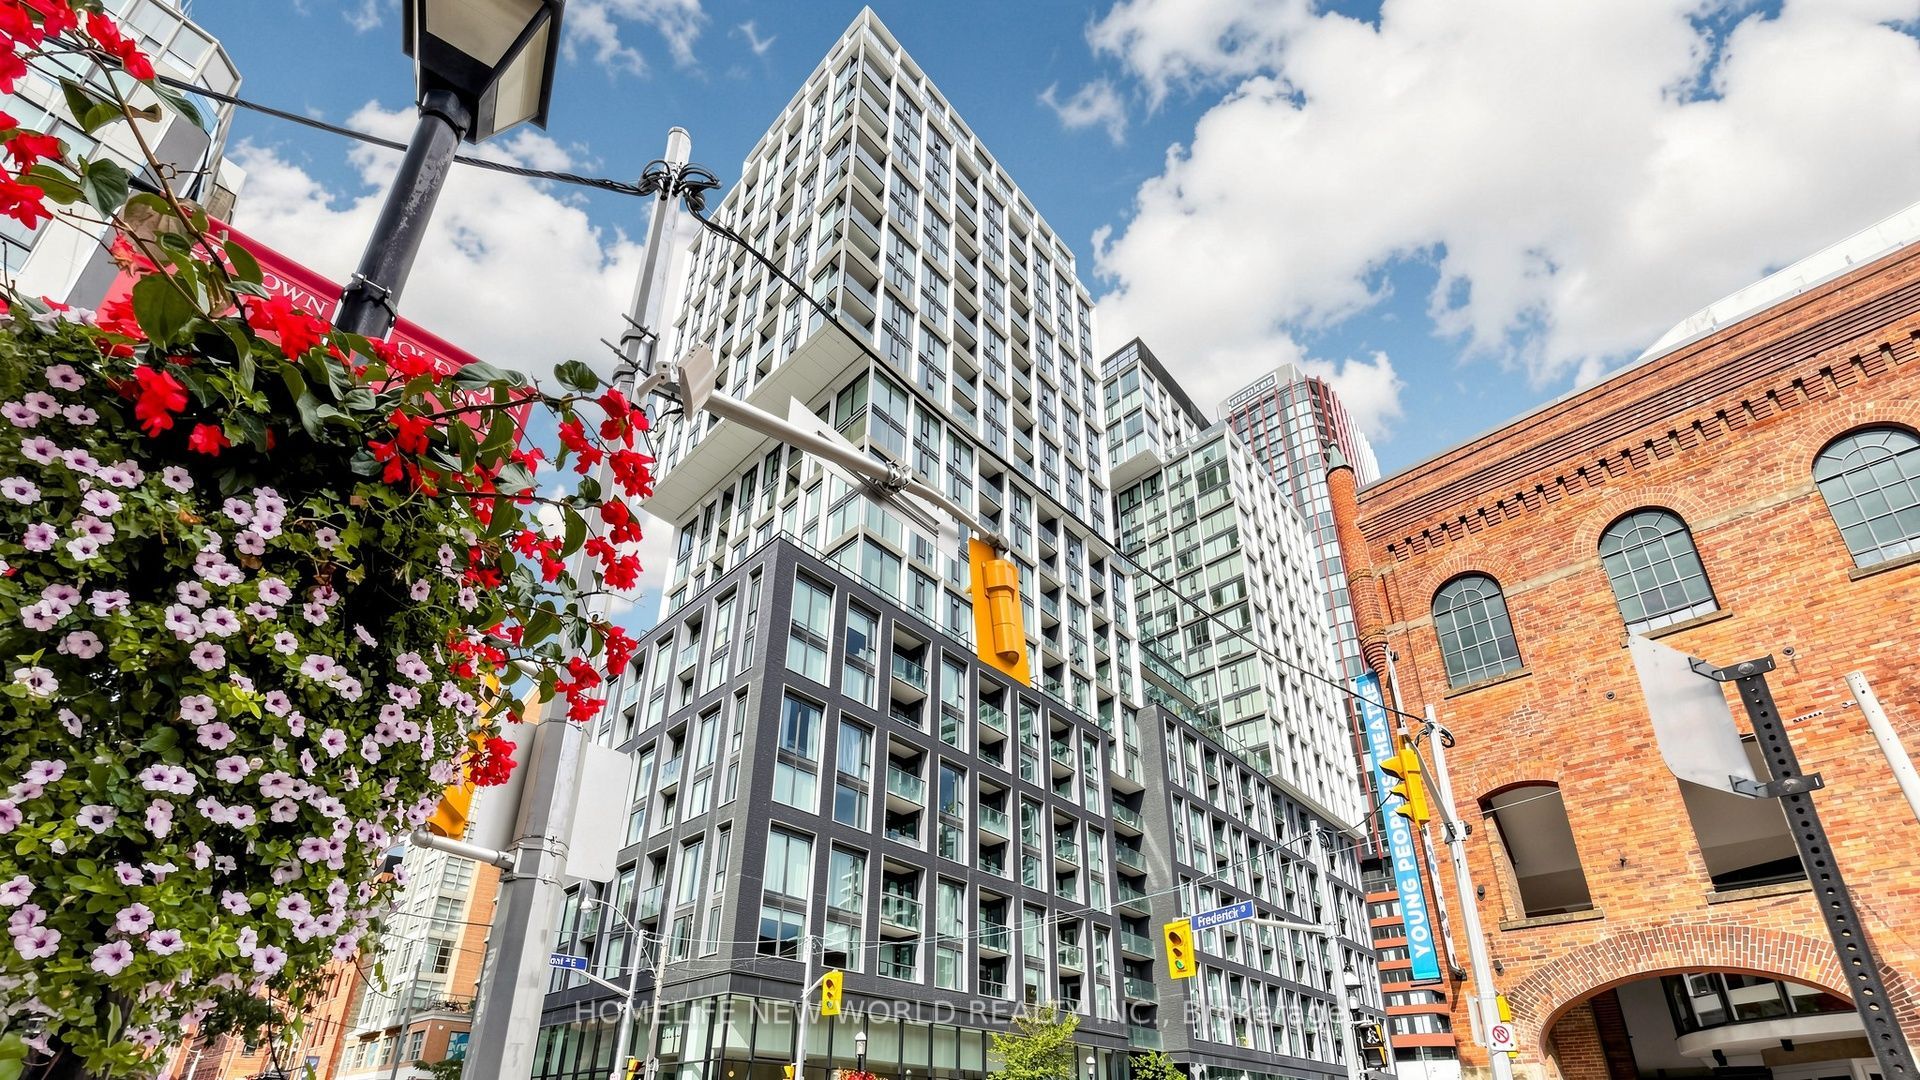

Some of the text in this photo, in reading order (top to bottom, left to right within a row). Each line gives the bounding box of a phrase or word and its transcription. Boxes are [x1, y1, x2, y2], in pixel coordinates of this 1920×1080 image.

[1362, 682, 1391, 764] HEATRE
[1197, 907, 1239, 928] Frederick
[1402, 877, 1432, 959] YOUNG
[571, 958, 577, 967] E
